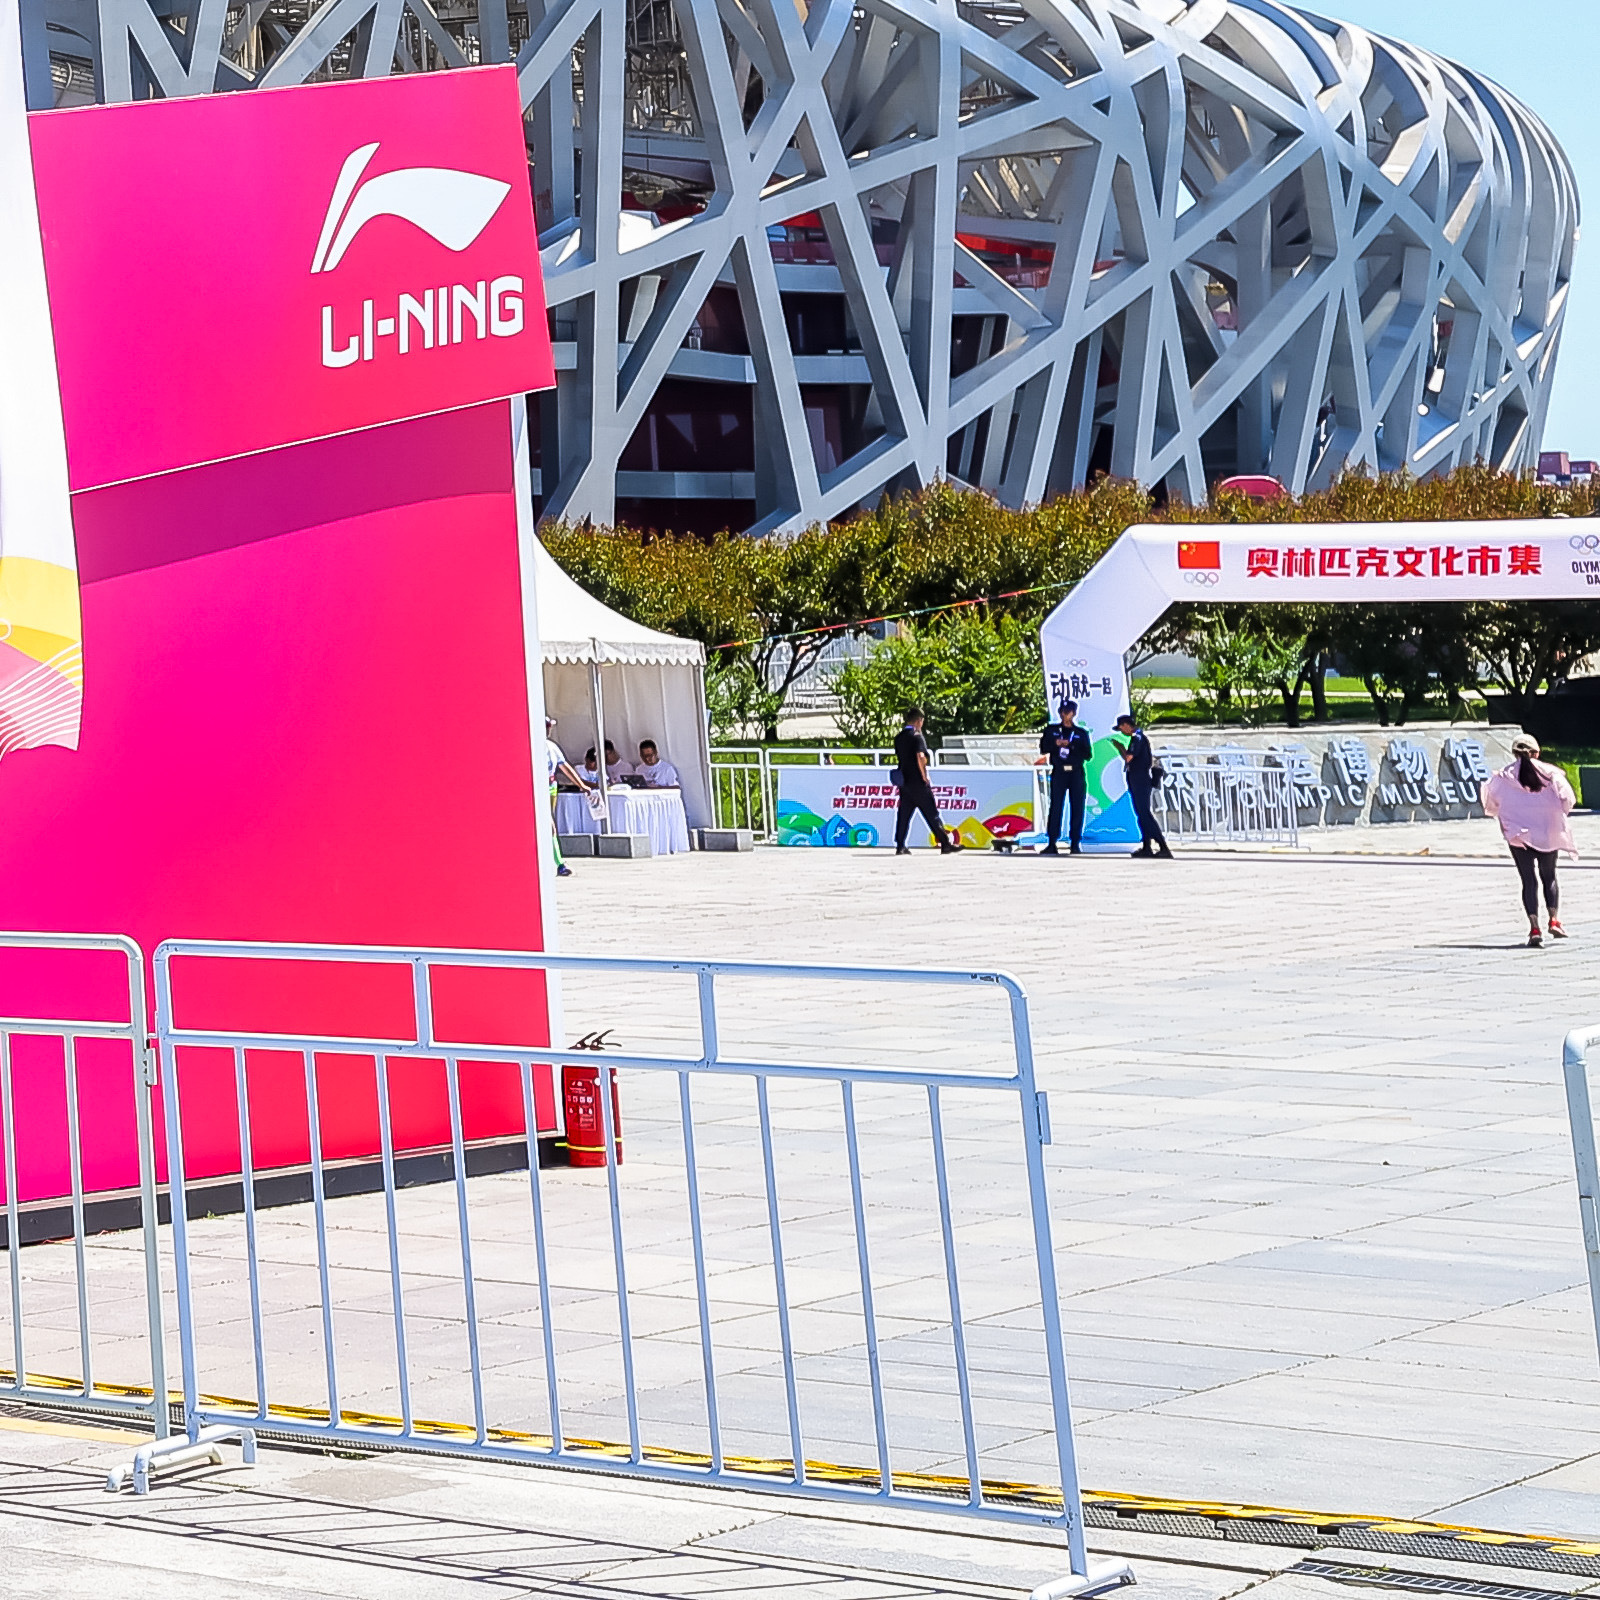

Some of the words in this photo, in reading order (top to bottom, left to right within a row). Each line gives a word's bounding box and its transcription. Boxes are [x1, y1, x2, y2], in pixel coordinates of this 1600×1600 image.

[321, 274, 525, 368] LI-NING
[1246, 544, 1543, 578] 奥林匹克文化市集
[1571, 560, 1600, 574] OLYM
[1586, 574, 1600, 585] DA
[1158, 737, 1492, 788] 京奥运博物馆
[1381, 780, 1481, 806] MUSEU
